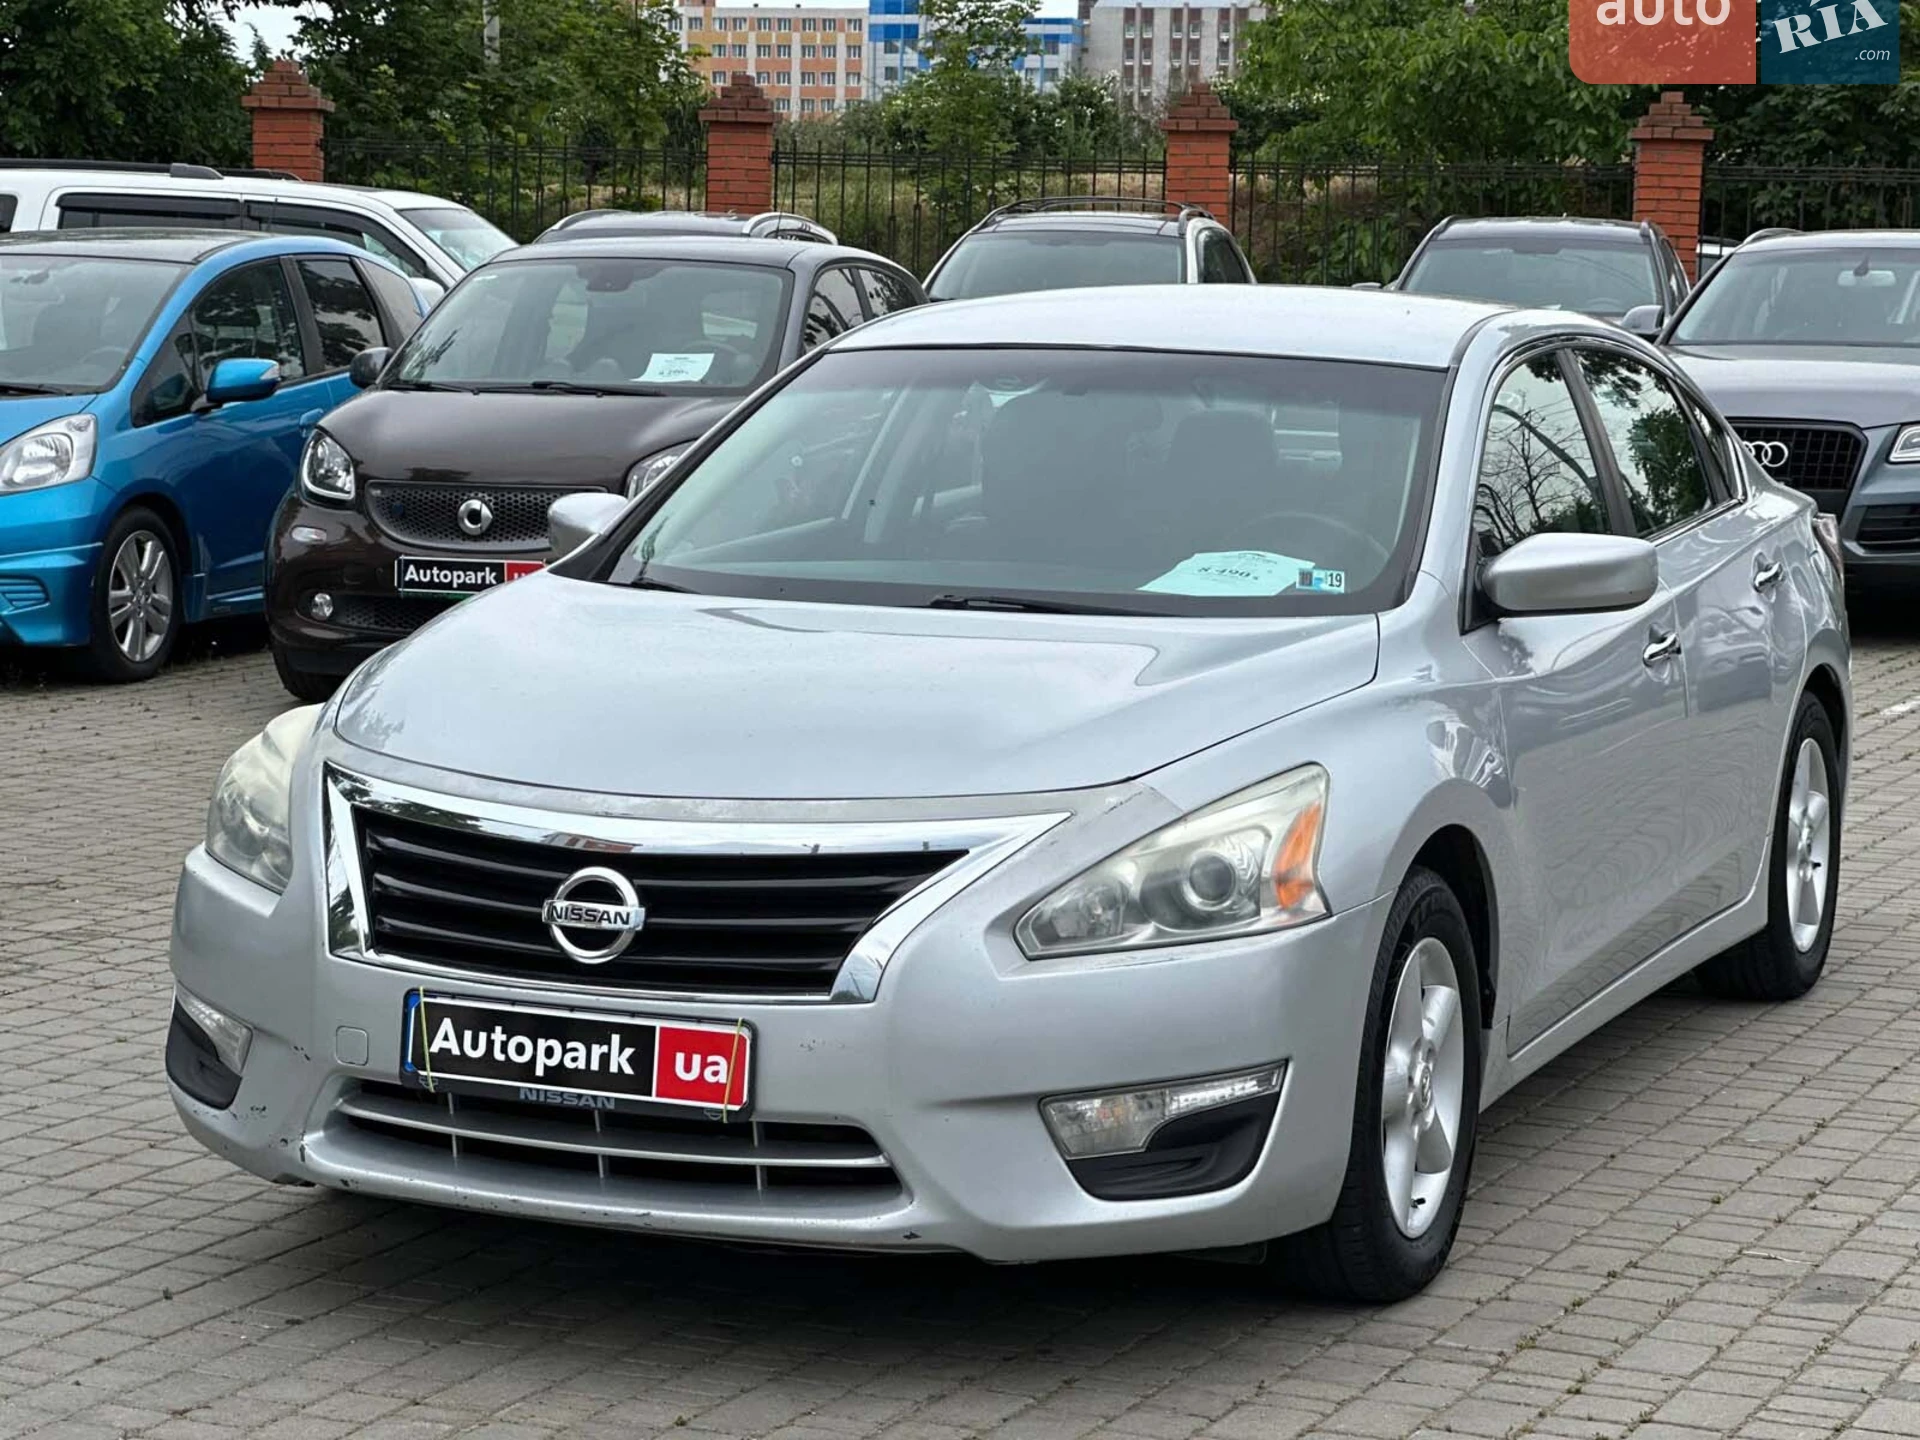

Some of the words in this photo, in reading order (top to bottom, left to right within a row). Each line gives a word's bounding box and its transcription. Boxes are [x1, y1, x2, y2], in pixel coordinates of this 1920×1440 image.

[404, 564, 497, 588] Autopark
[1328, 572, 1342, 588] 19
[550, 905, 631, 926] NISSAN
[430, 1017, 636, 1077] Autopark
[674, 1051, 730, 1084] ua
[520, 1087, 616, 1110] NISSAN
